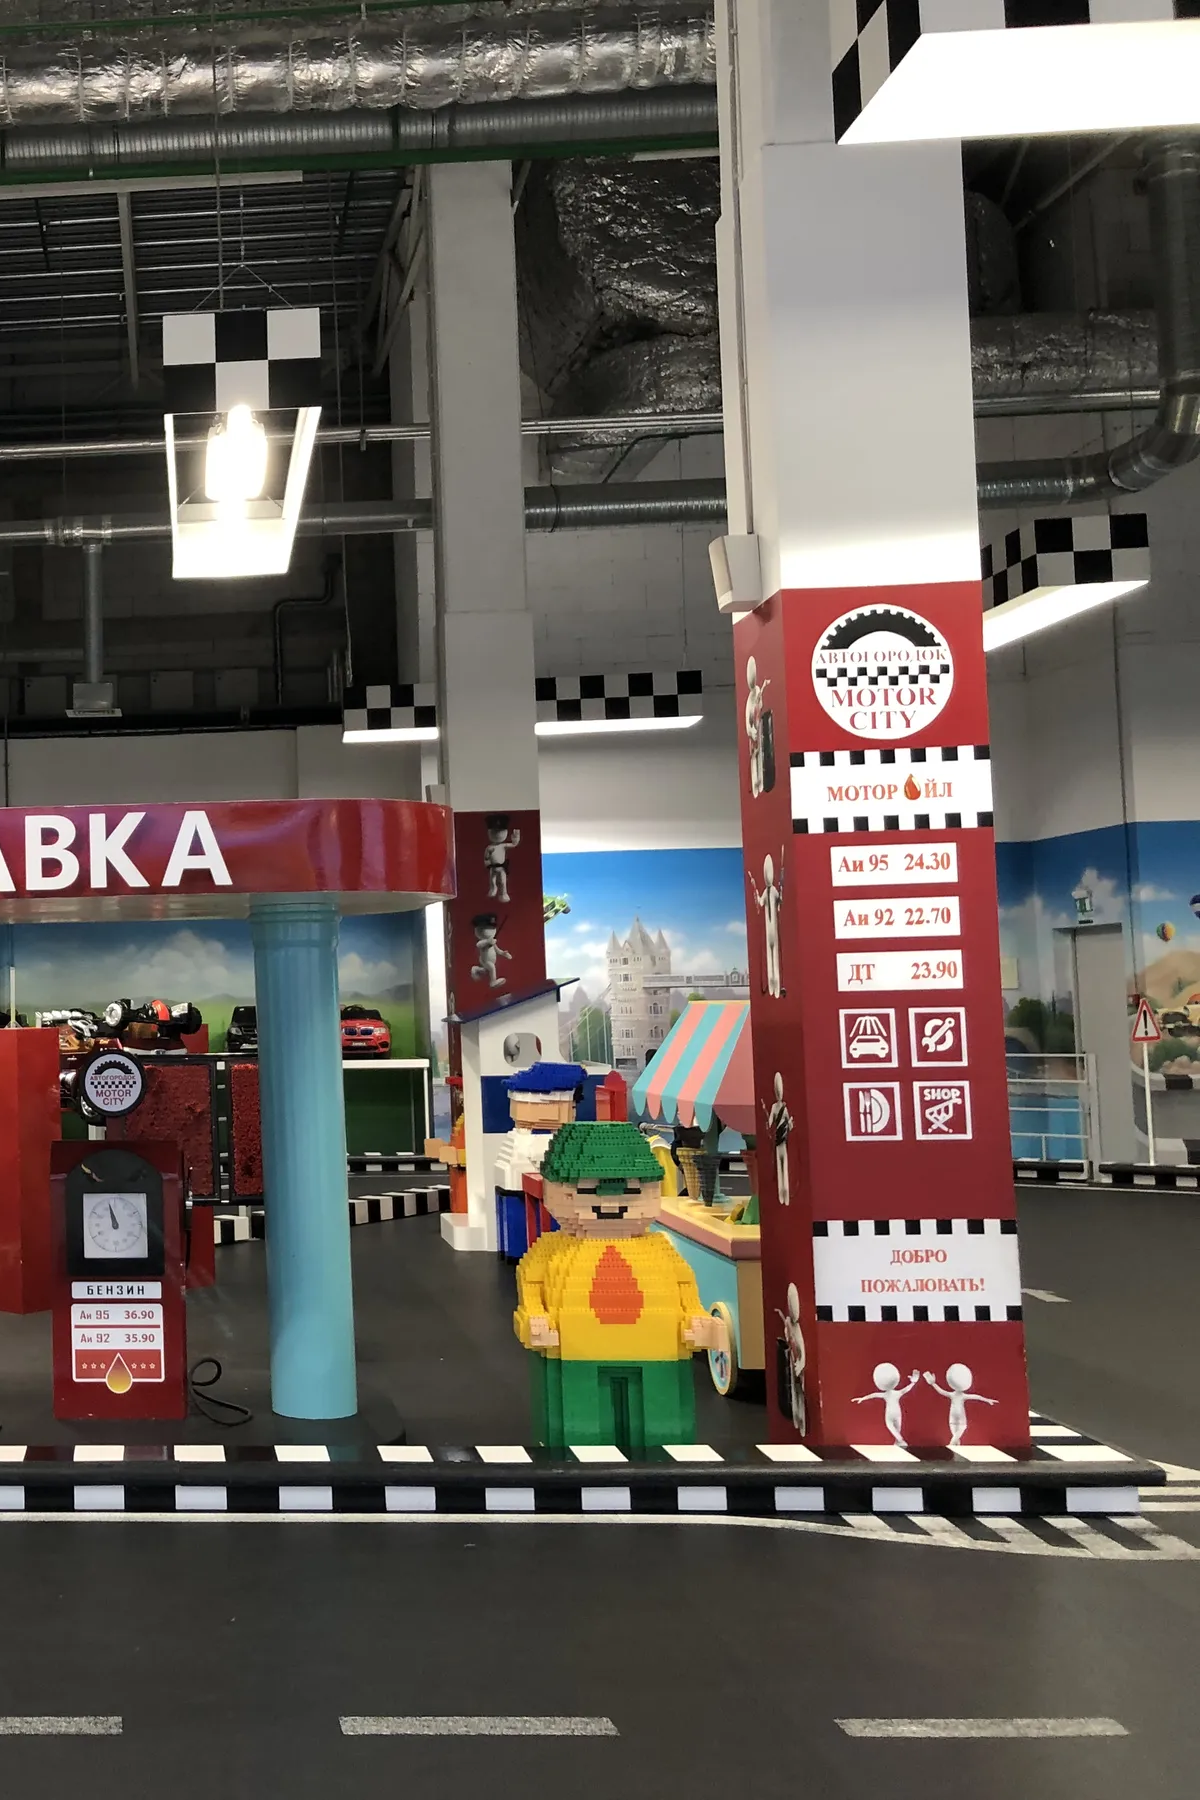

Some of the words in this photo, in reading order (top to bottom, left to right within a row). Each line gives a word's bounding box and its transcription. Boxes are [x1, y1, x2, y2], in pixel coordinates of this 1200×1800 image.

[816, 649, 947, 664] АВТОГОРОДОК
[831, 687, 937, 707] MOTOR
[850, 711, 916, 730] CITY
[838, 856, 864, 872] Аи
[869, 854, 889, 871] 95
[904, 852, 950, 871] 24.30
[843, 910, 869, 926] Аи
[874, 908, 895, 926] 92
[904, 907, 951, 925] 22.70
[847, 964, 875, 985] ДТ
[911, 961, 957, 980] 23.90
[95, 1089, 131, 1097] MOTOR
[923, 1088, 961, 1100] SHOP
[102, 1097, 124, 1105] CITY
[890, 1249, 947, 1265] ДОБРО
[86, 1285, 145, 1295] БЕНЗИН
[860, 1278, 985, 1293] ПОЖАЛОВАТЬ!
[79, 1310, 92, 1320] Аи
[95, 1310, 110, 1320] 95
[124, 1310, 154, 1320] 36.90
[80, 1333, 93, 1343] Аи
[96, 1333, 110, 1343] 92
[124, 1333, 155, 1343] 35.90
